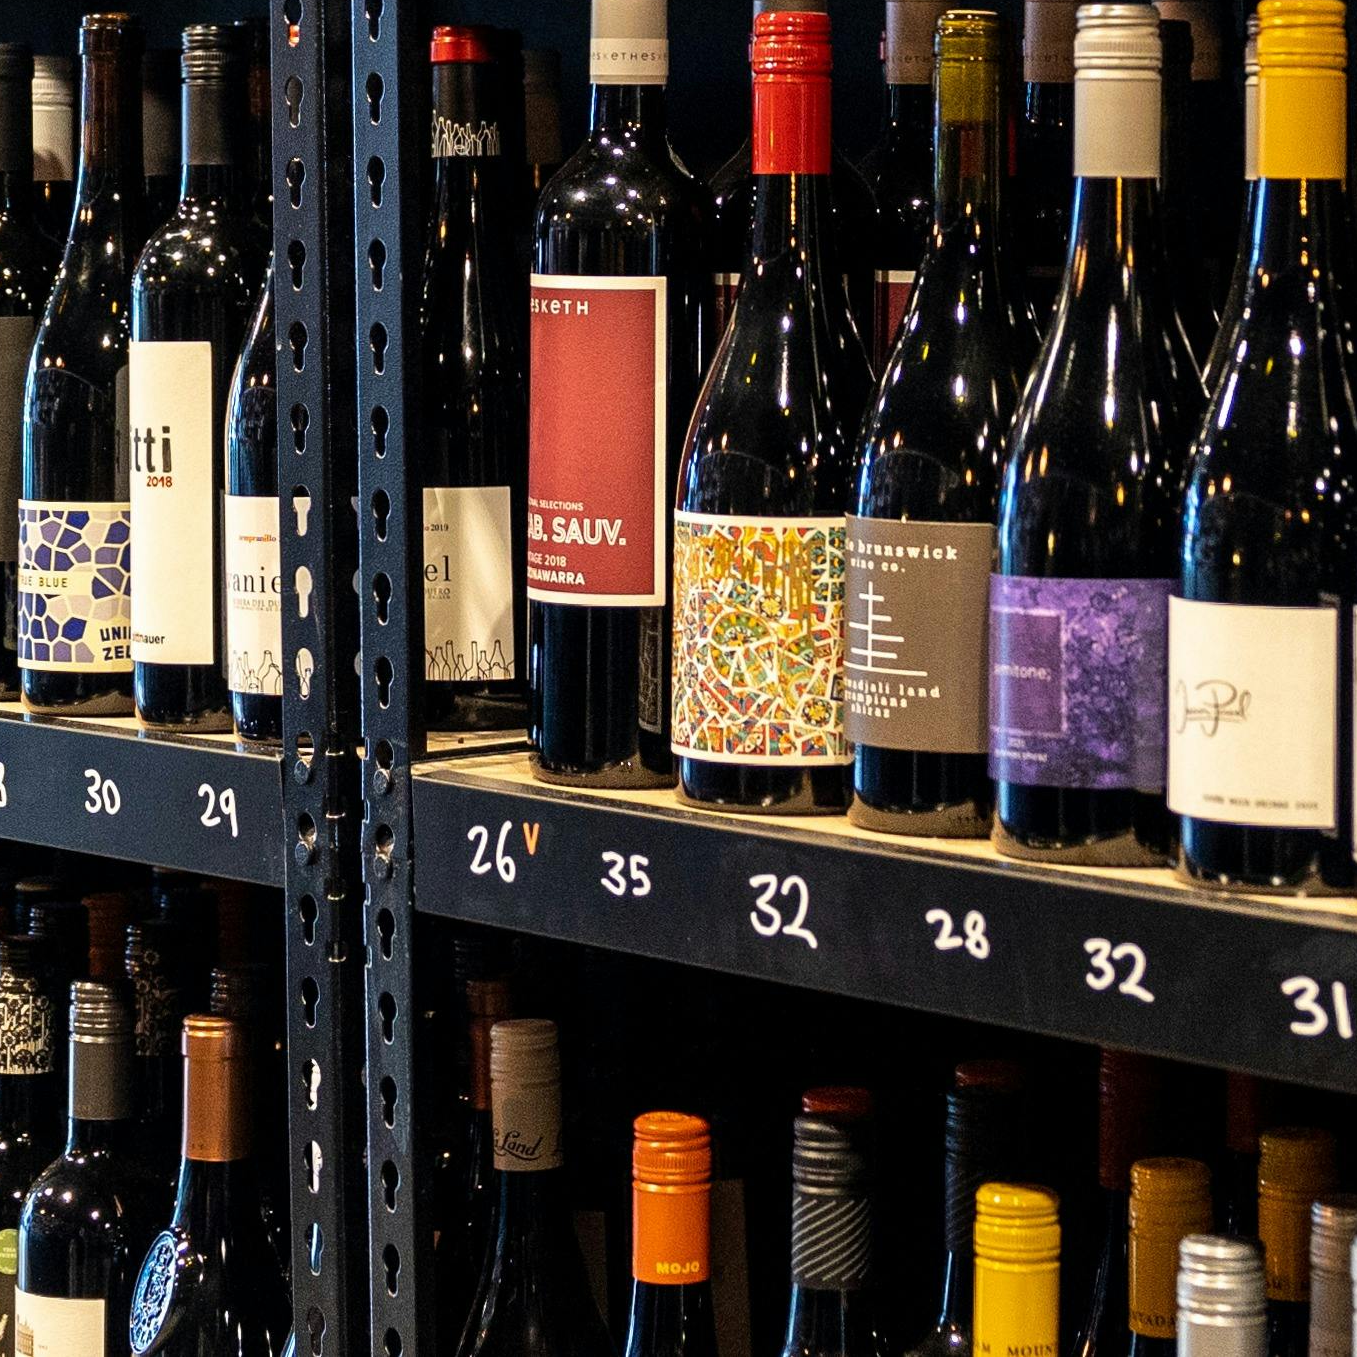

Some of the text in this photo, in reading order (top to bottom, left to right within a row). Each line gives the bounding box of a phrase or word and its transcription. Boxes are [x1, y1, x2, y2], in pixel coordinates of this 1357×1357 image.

[145, 475, 173, 489] 2018
[539, 500, 584, 512] SELECTIONS
[430, 524, 449, 532] 2019
[551, 517, 627, 546] SAUV.
[858, 540, 958, 560] brunswick
[544, 554, 567, 568] 2018
[881, 560, 906, 573] co.
[38, 577, 68, 589] BLUE
[899, 684, 941, 699] land
[850, 703, 891, 719] shiraz
[84, 769, 122, 815] 30
[198, 784, 239, 838] 29
[467, 822, 516, 884] 26
[601, 851, 652, 898] 35
[749, 874, 819, 950] 32
[926, 909, 990, 960] 28
[1083, 938, 1156, 1004] 32
[1281, 976, 1354, 1040] 31
[656, 1259, 701, 1277] MOJO
